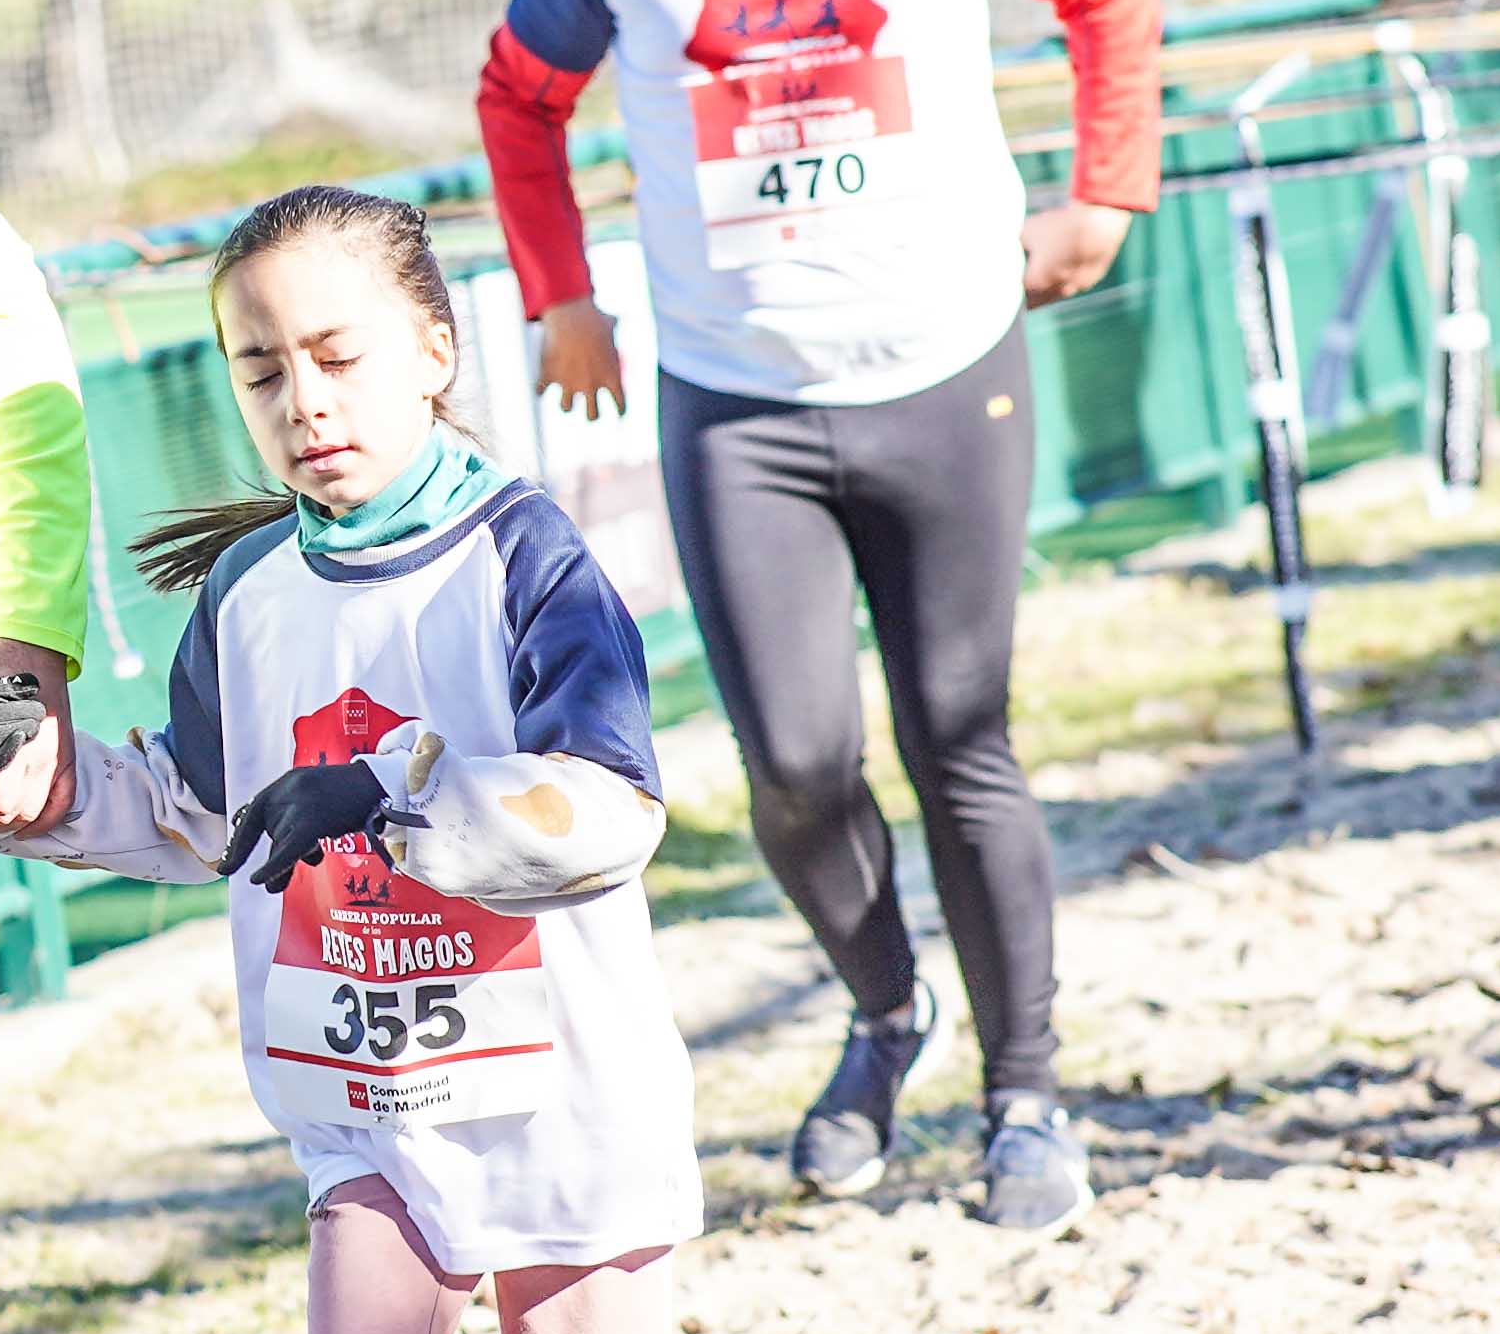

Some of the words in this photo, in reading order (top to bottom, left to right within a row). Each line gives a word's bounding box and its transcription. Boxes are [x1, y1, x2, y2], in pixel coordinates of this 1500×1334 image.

[758, 153, 864, 204] 470
[330, 908, 369, 924] CARRERA
[371, 913, 442, 925] POPULAR
[362, 926, 371, 935] de
[371, 926, 381, 935] los
[320, 925, 367, 974] REYES
[372, 931, 475, 977] MAGOS
[324, 983, 467, 1061] 355
[369, 1075, 450, 1099] Comunidad
[372, 1099, 390, 1113] de
[394, 1092, 452, 1113] Madrid
